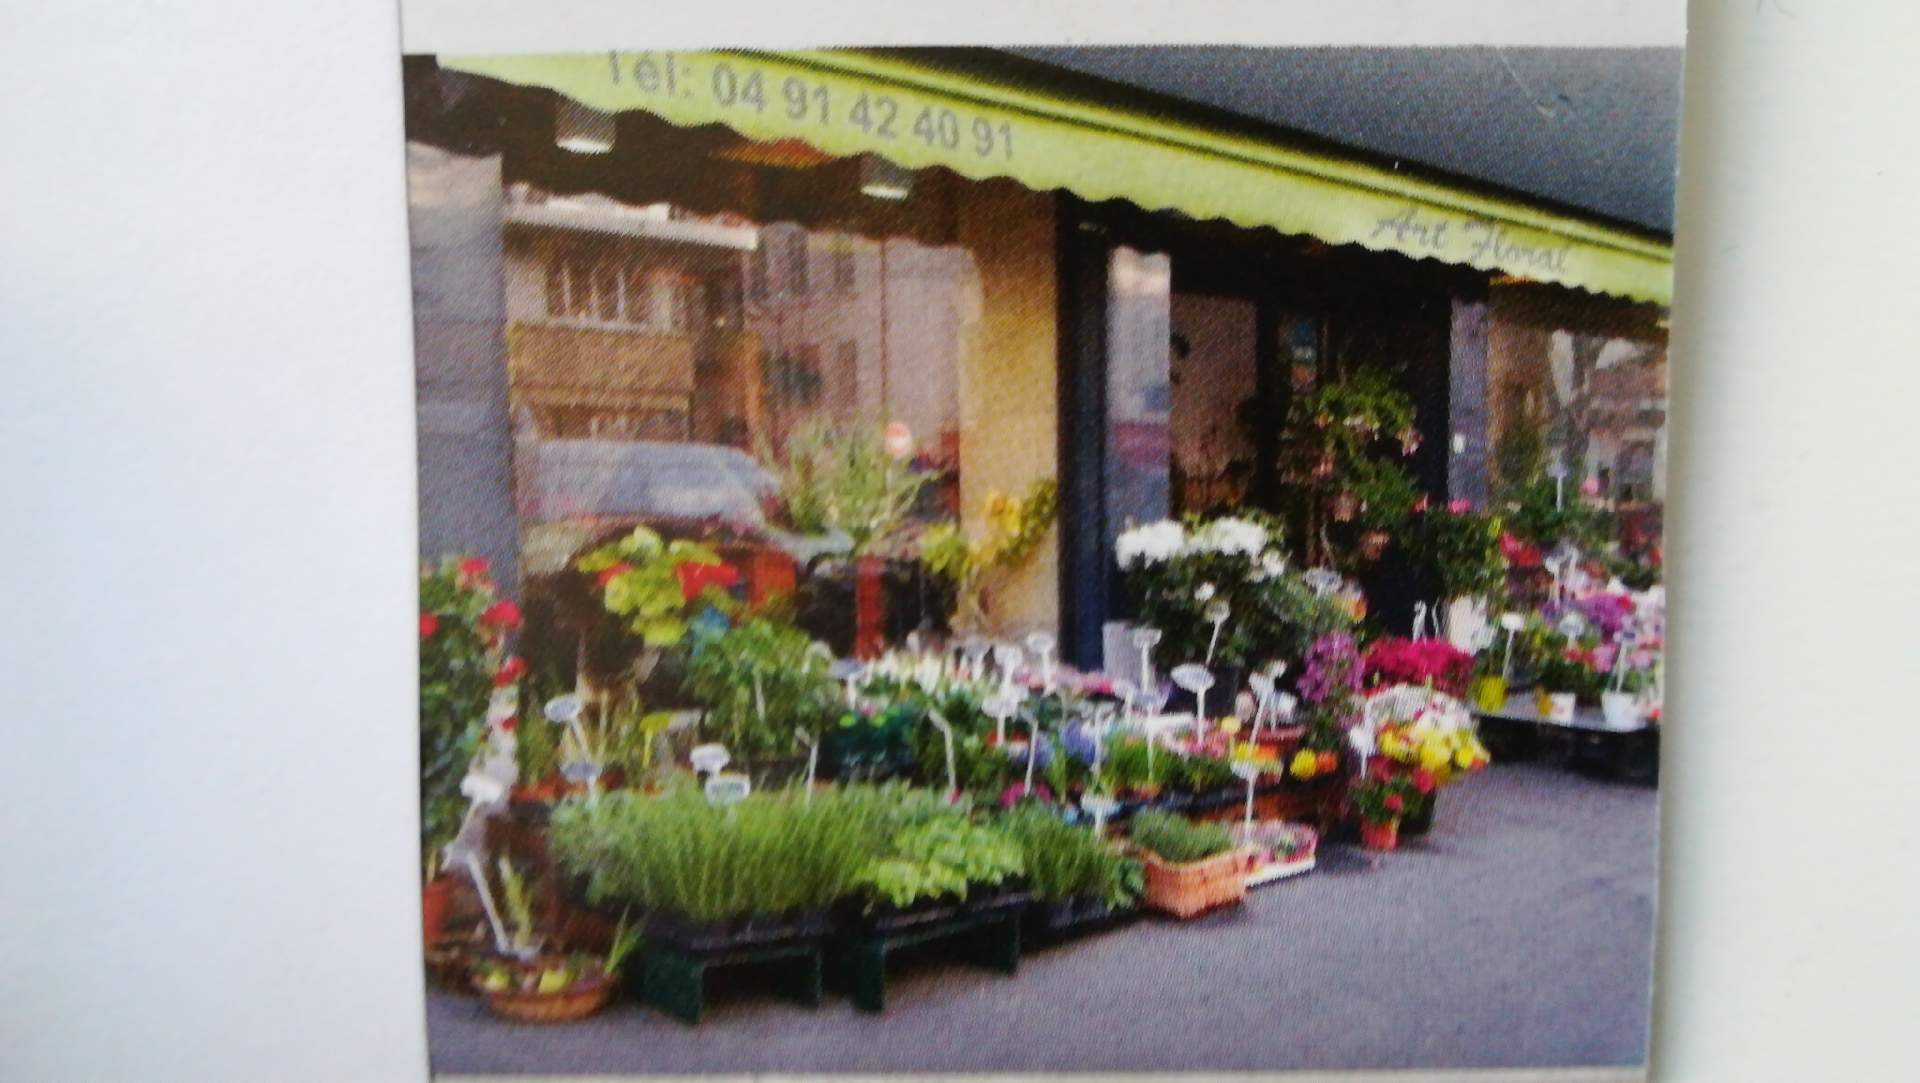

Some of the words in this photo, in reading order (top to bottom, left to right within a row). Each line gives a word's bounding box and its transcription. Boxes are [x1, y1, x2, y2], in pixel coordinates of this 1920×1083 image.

[711, 62, 767, 114] 04
[781, 76, 829, 125] 91
[849, 91, 897, 140] 42
[913, 106, 960, 150] 40
[972, 116, 1013, 160] 91
